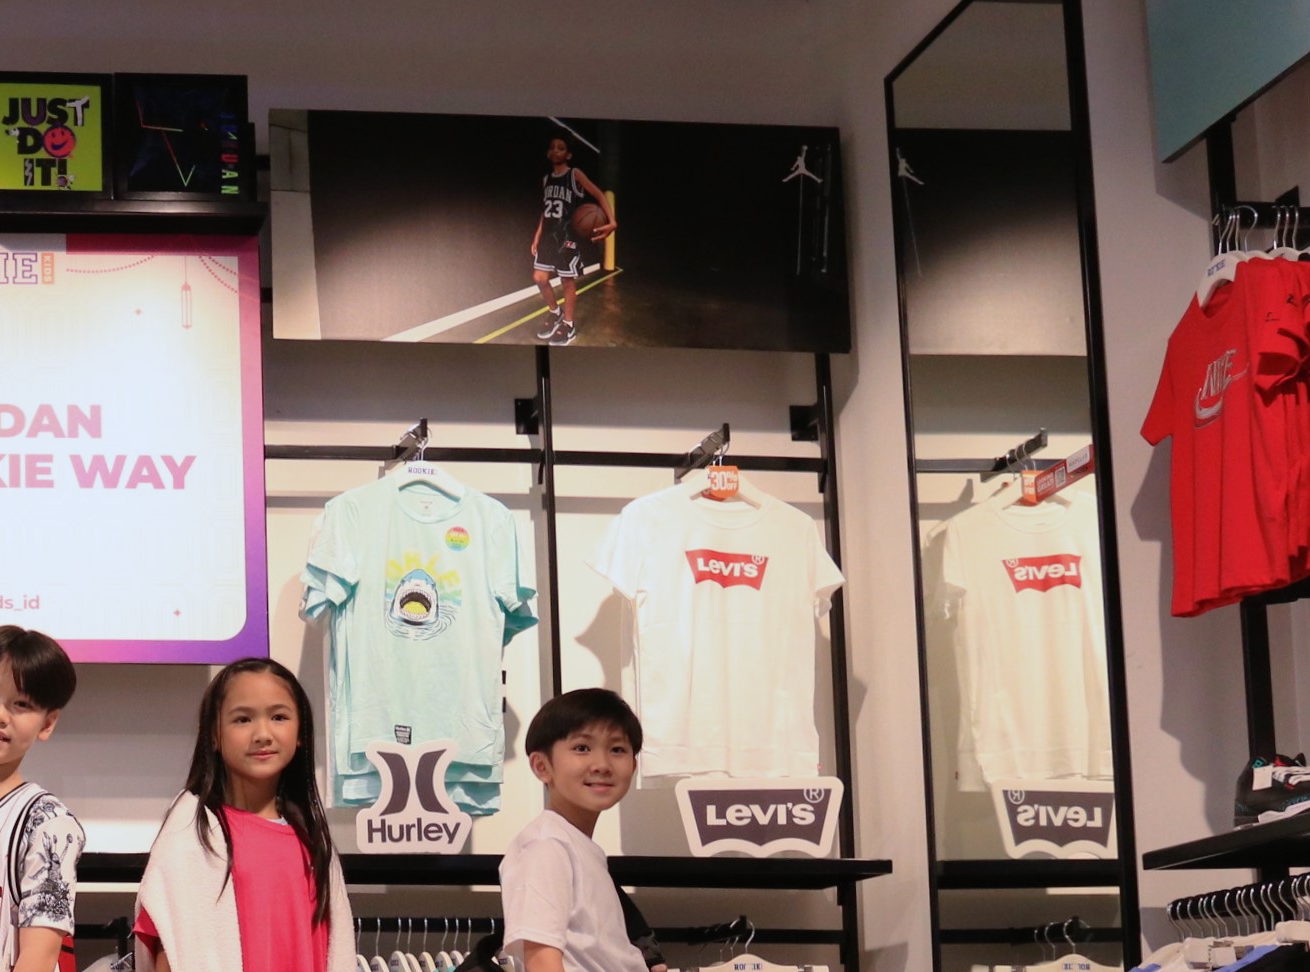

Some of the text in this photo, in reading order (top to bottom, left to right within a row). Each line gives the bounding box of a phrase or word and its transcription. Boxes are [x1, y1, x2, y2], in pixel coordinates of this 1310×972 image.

[2, 97, 90, 126] JUST
[17, 123, 76, 158] DO
[24, 158, 74, 190] IT!
[544, 200, 563, 218] 23
[1200, 349, 1237, 401] NIKE
[69, 453, 197, 490] WAY
[710, 471, 737, 491] 30%
[367, 817, 461, 845] Hurley
